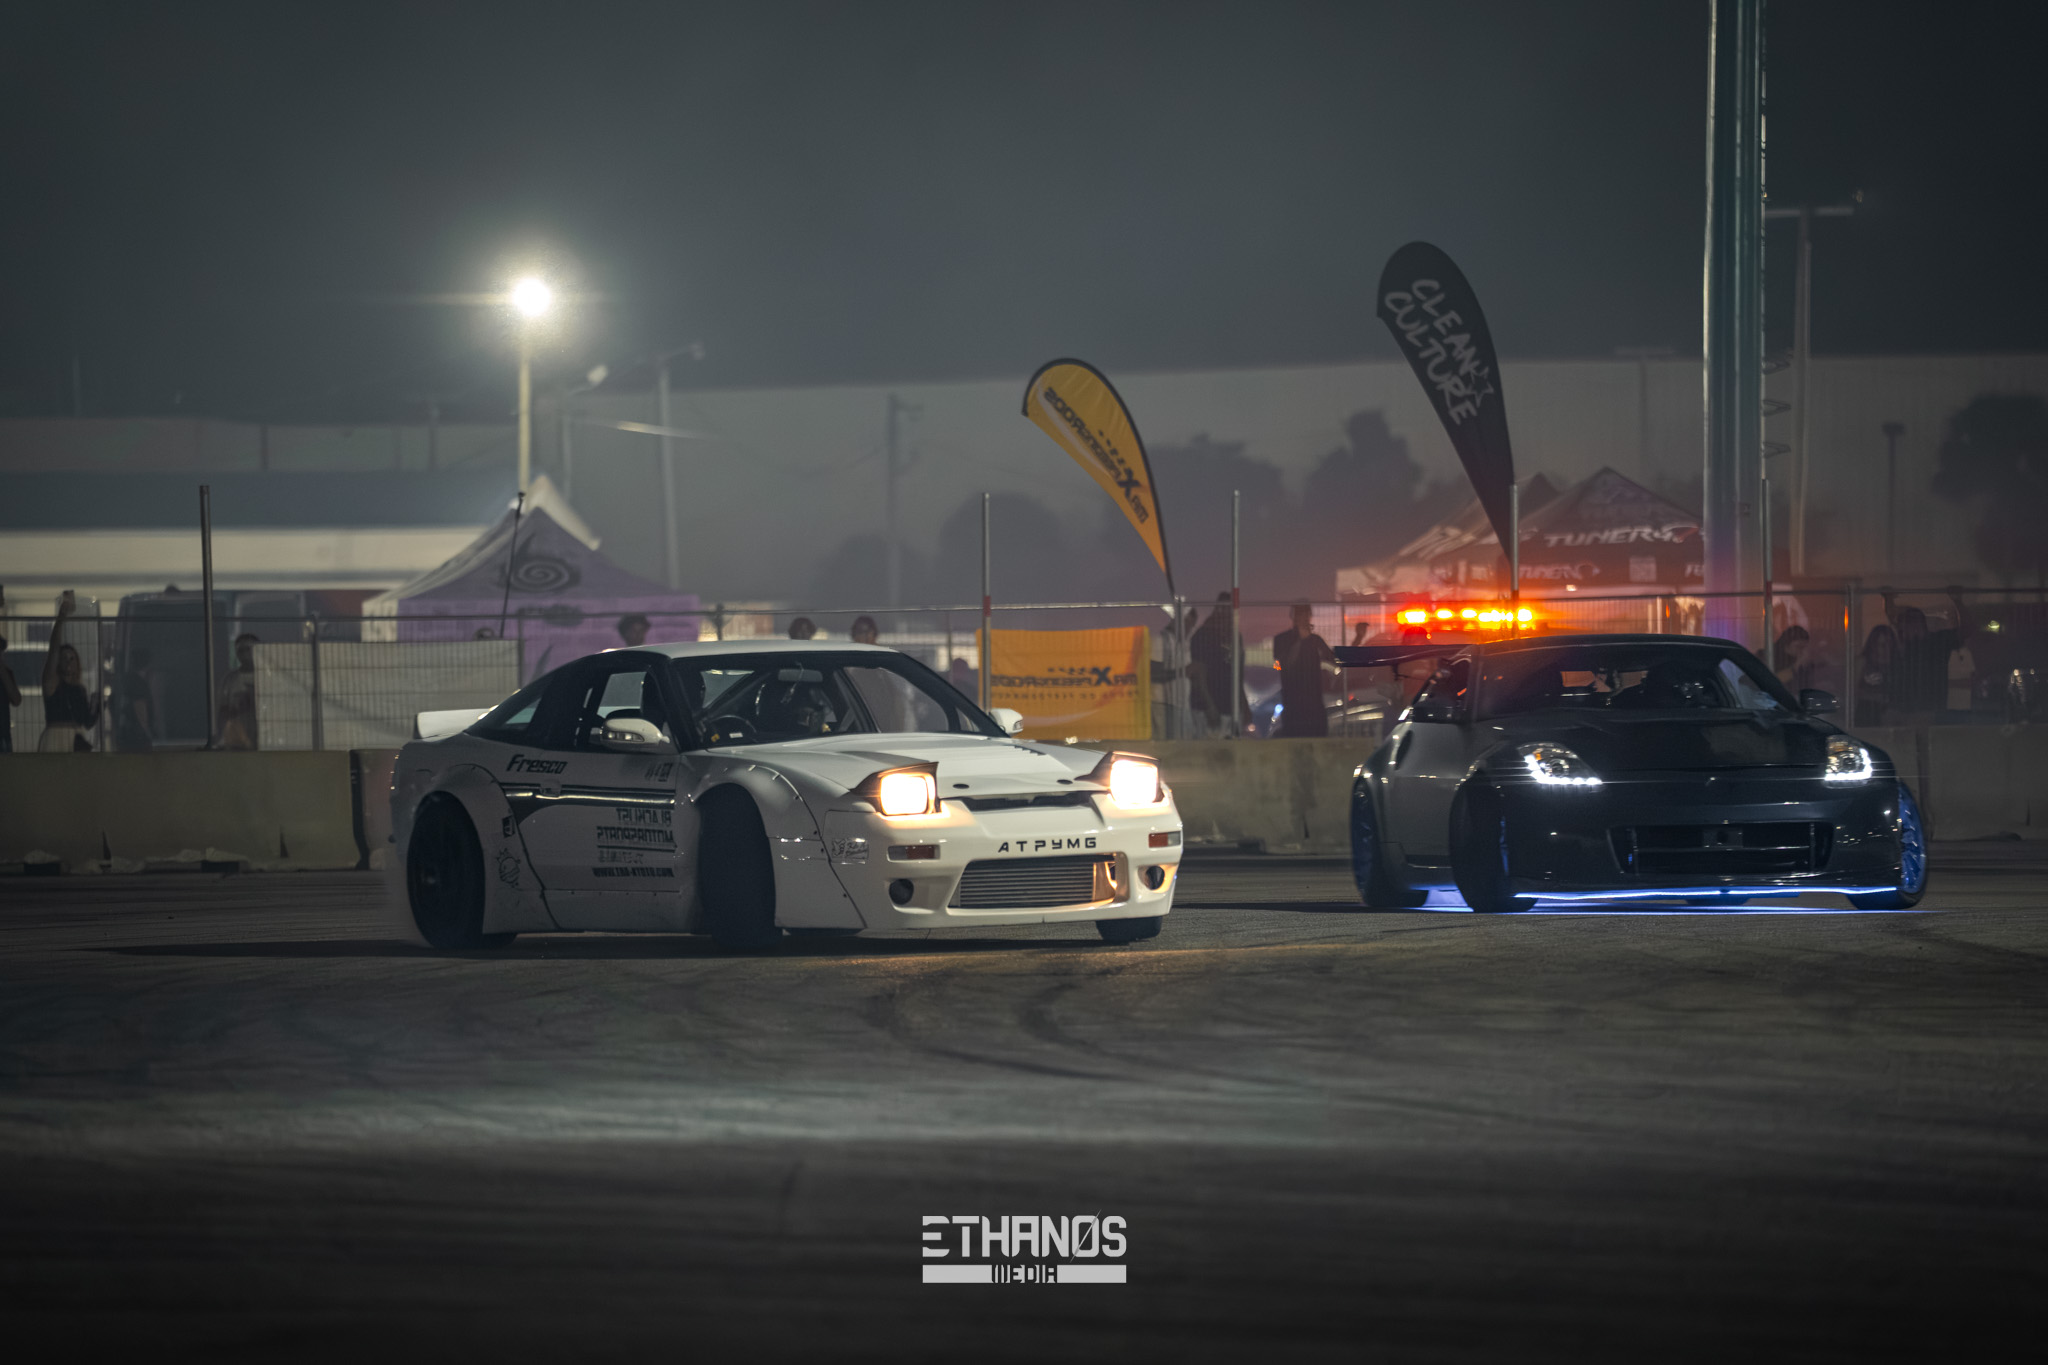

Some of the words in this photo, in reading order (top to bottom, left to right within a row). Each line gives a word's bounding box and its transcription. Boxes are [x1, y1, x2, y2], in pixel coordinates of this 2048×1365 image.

[1384, 291, 1478, 425] CULTURE
[1411, 279, 1481, 377] CLEAN
[506, 754, 568, 774] Fresco
